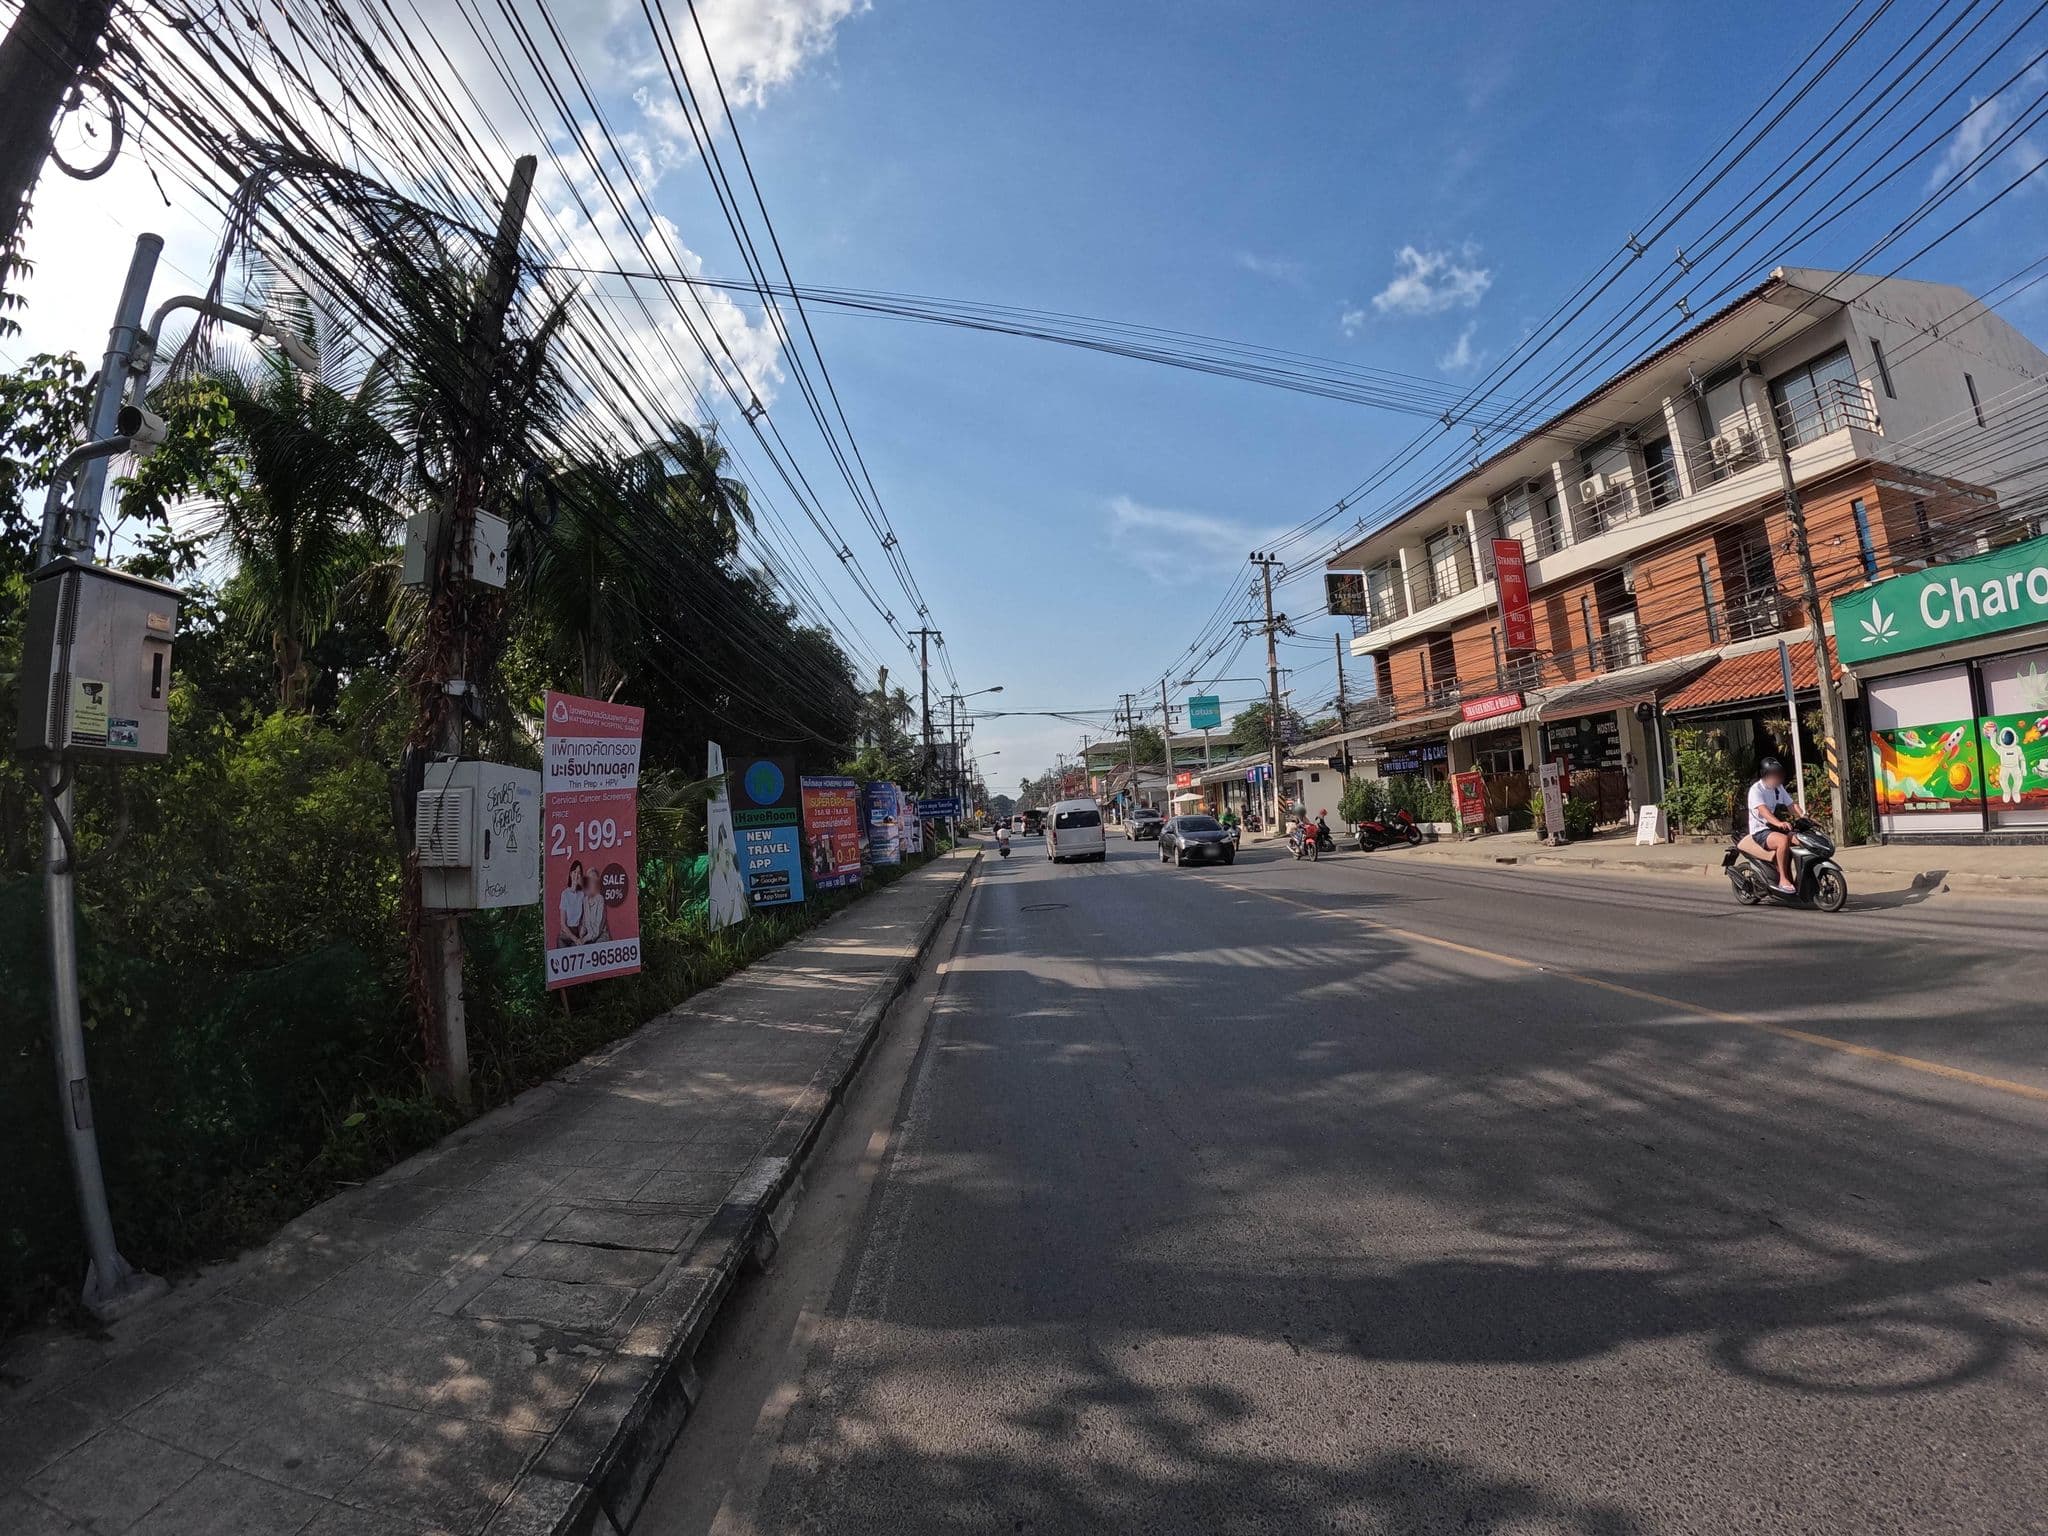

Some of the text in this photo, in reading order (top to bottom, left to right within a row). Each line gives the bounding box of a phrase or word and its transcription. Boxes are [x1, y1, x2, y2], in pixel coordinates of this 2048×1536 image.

[1919, 567, 2048, 629] Charo
[552, 739, 637, 756] แพ็กเกจคัดกรอง
[551, 758, 635, 779] มะเร็งปากมดลูก
[569, 780, 582, 789] Thin
[583, 780, 598, 789] Prep
[605, 779, 619, 787] HPV
[551, 791, 632, 805] Cervical Cancer Screening
[552, 810, 569, 818] PRICE
[735, 811, 796, 823] iHaveRoom
[746, 830, 772, 842] NEW
[747, 843, 790, 855] TRAVEL
[749, 858, 771, 869] APP
[602, 874, 625, 886] SALE
[760, 877, 777, 885] Google
[778, 876, 788, 884] Play
[605, 888, 623, 901] 50%
[763, 892, 773, 901] App
[774, 891, 788, 899] Store
[561, 945, 638, 973] 077-965889
